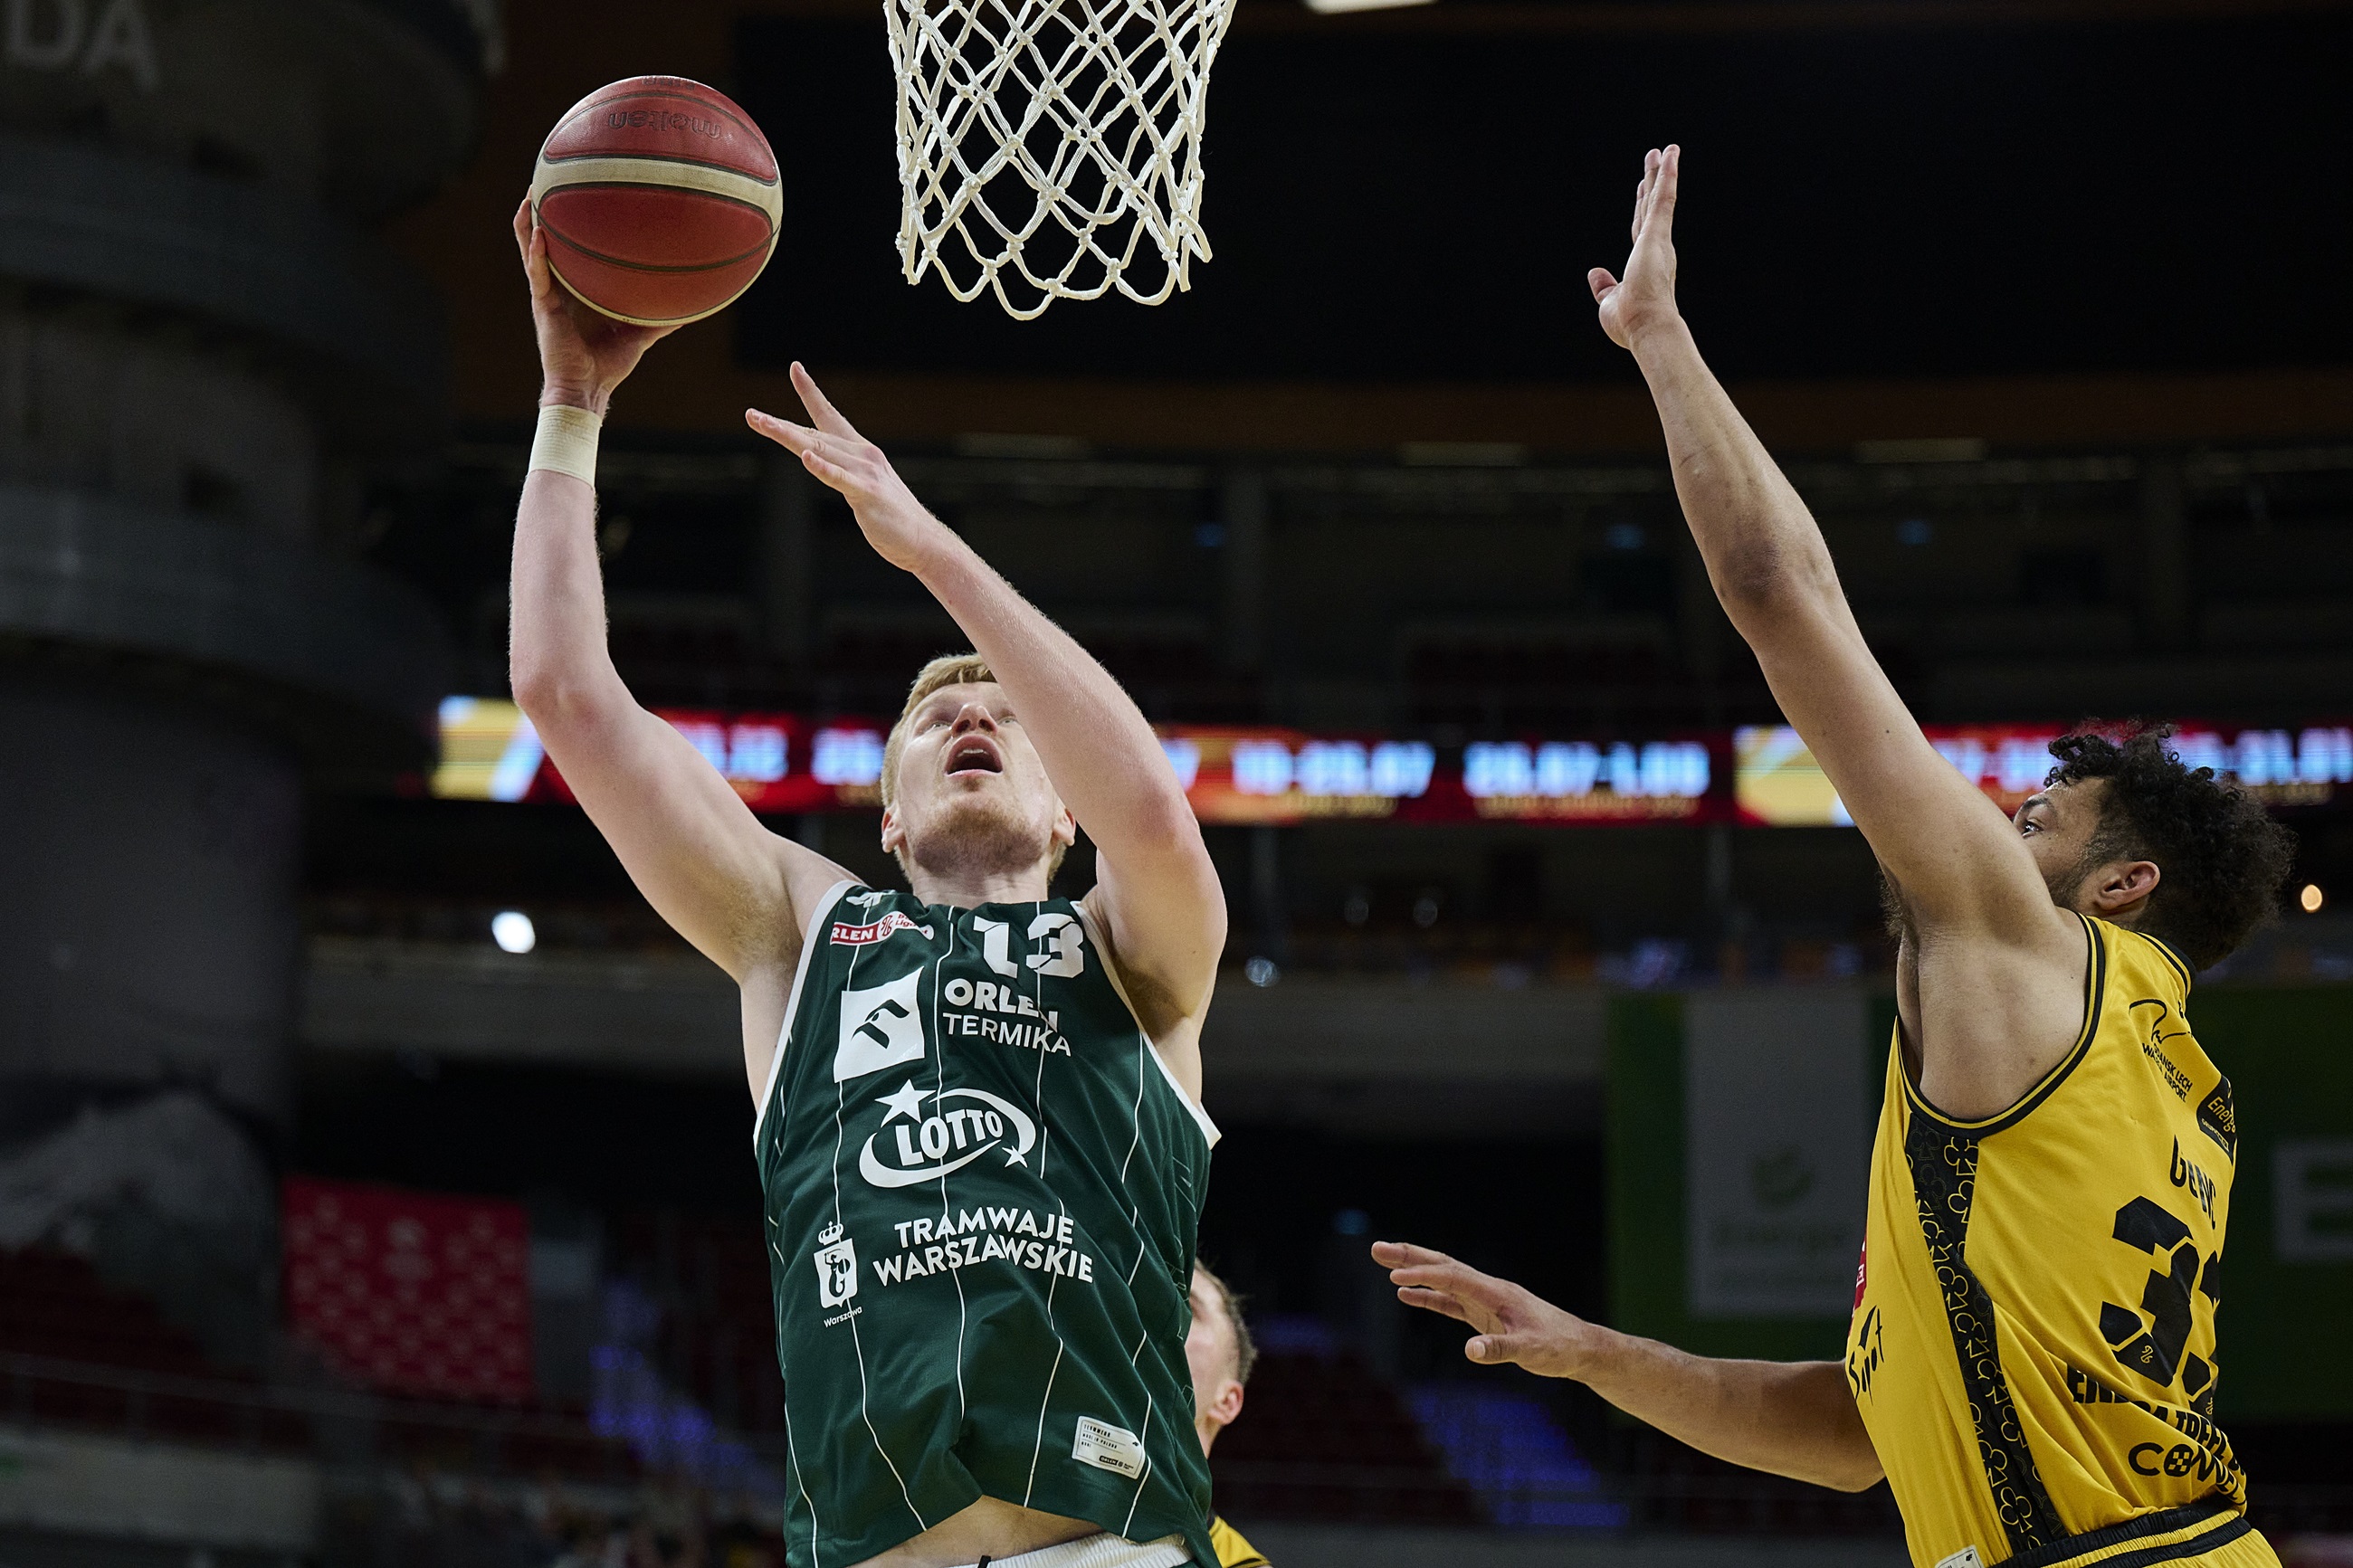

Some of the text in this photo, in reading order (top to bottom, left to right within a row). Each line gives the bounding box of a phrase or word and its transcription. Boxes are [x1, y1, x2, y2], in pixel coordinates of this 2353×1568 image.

[831, 927, 874, 941] RLEN
[973, 913, 1084, 979] 13
[942, 1012, 1072, 1058] TERMIKA
[894, 1108, 1004, 1167] LOTTO
[894, 1206, 1074, 1249] TRAMWAJE
[872, 1233, 1094, 1287] WARSZAWSKIE
[824, 1306, 862, 1328] Warszawa
